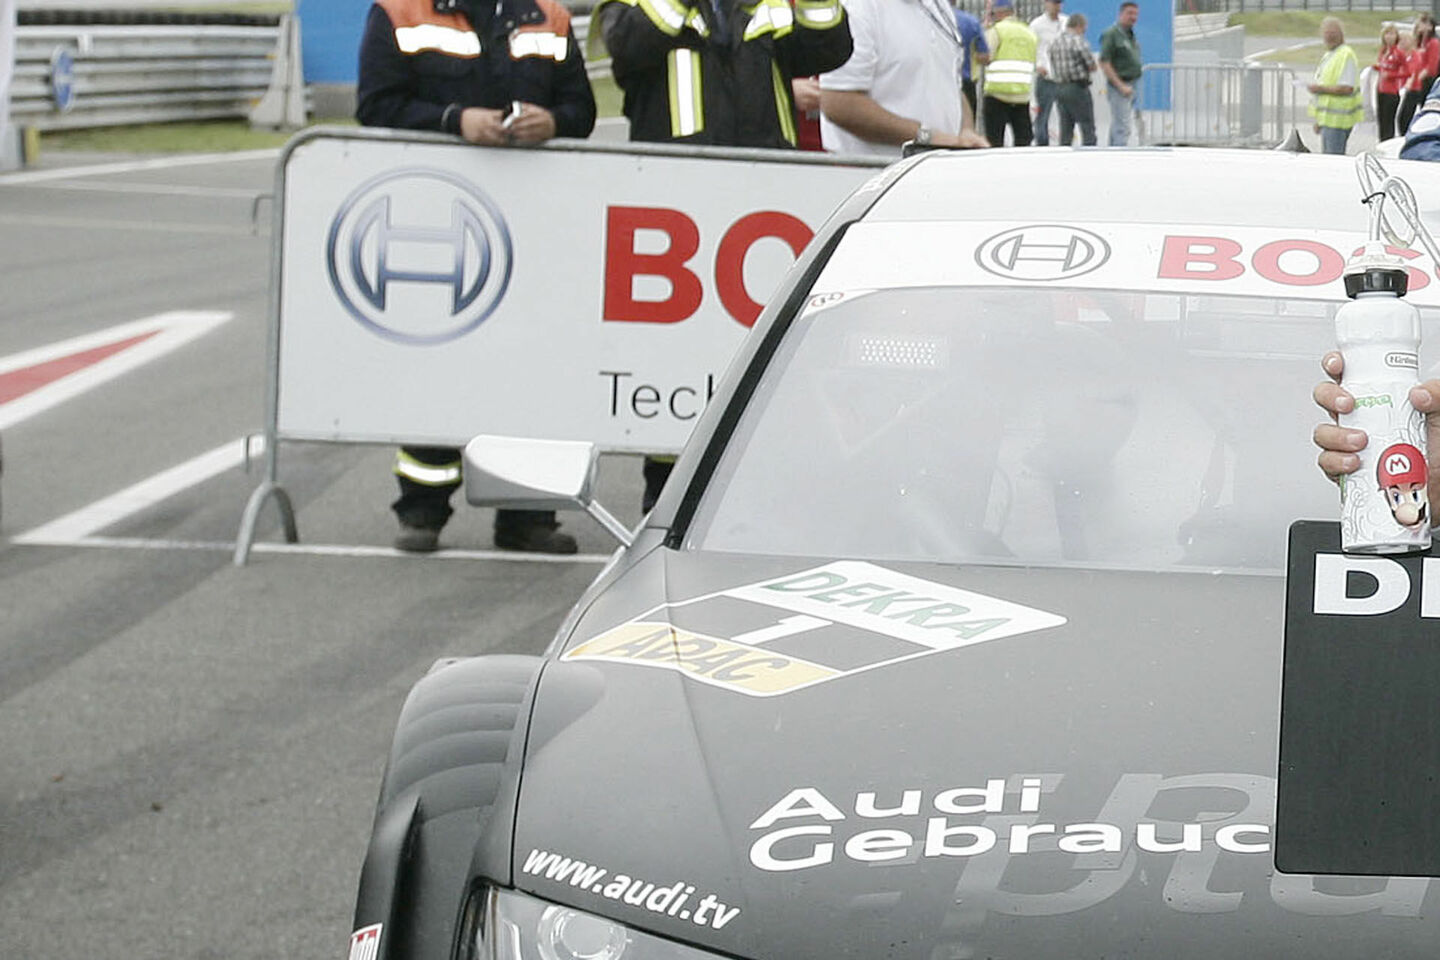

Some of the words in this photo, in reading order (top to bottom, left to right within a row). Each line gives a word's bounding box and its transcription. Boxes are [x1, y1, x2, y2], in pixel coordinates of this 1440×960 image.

[760, 571, 1012, 641] DEKRA
[606, 630, 790, 683] ADAC
[749, 778, 1042, 829] Audi
[523, 848, 741, 930] www.audi.tv
